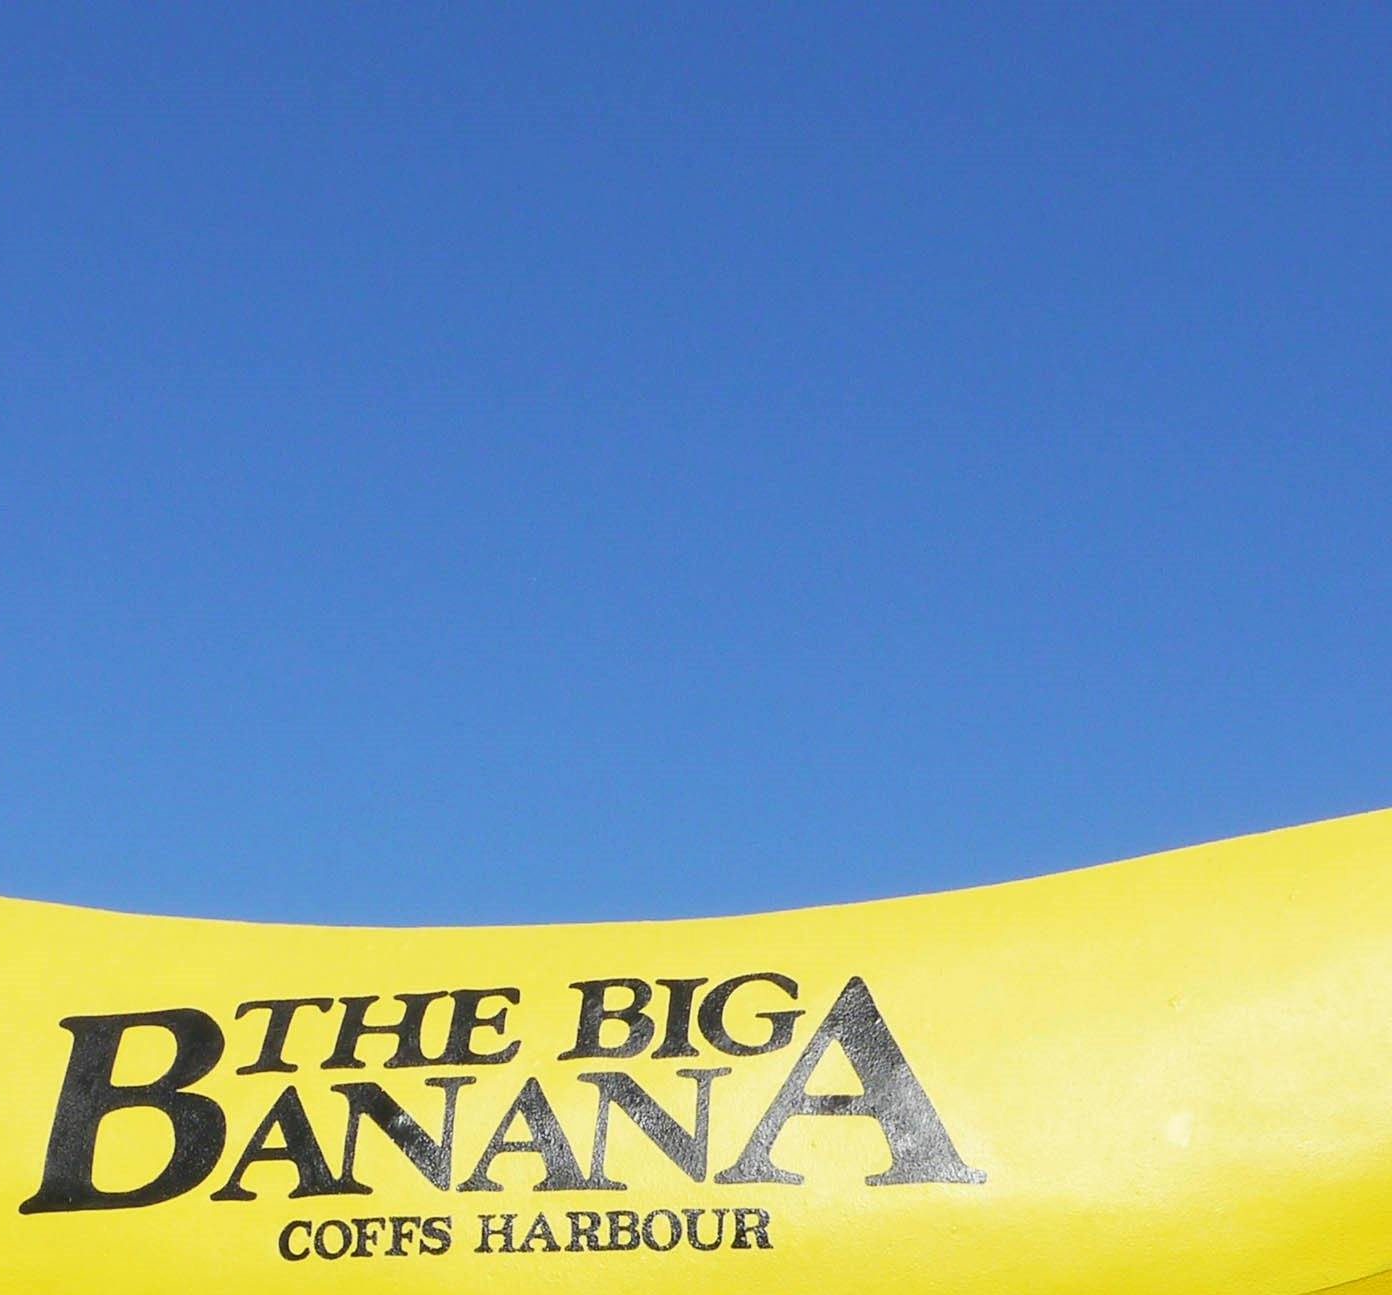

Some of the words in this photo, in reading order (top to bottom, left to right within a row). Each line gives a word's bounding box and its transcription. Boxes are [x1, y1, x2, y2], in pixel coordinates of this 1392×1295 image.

[236, 987, 522, 1075] THE
[558, 972, 805, 1061] BIG
[19, 976, 987, 1215] BANANA
[279, 1216, 452, 1261] COFFS
[475, 1210, 774, 1256] HARBOUR
